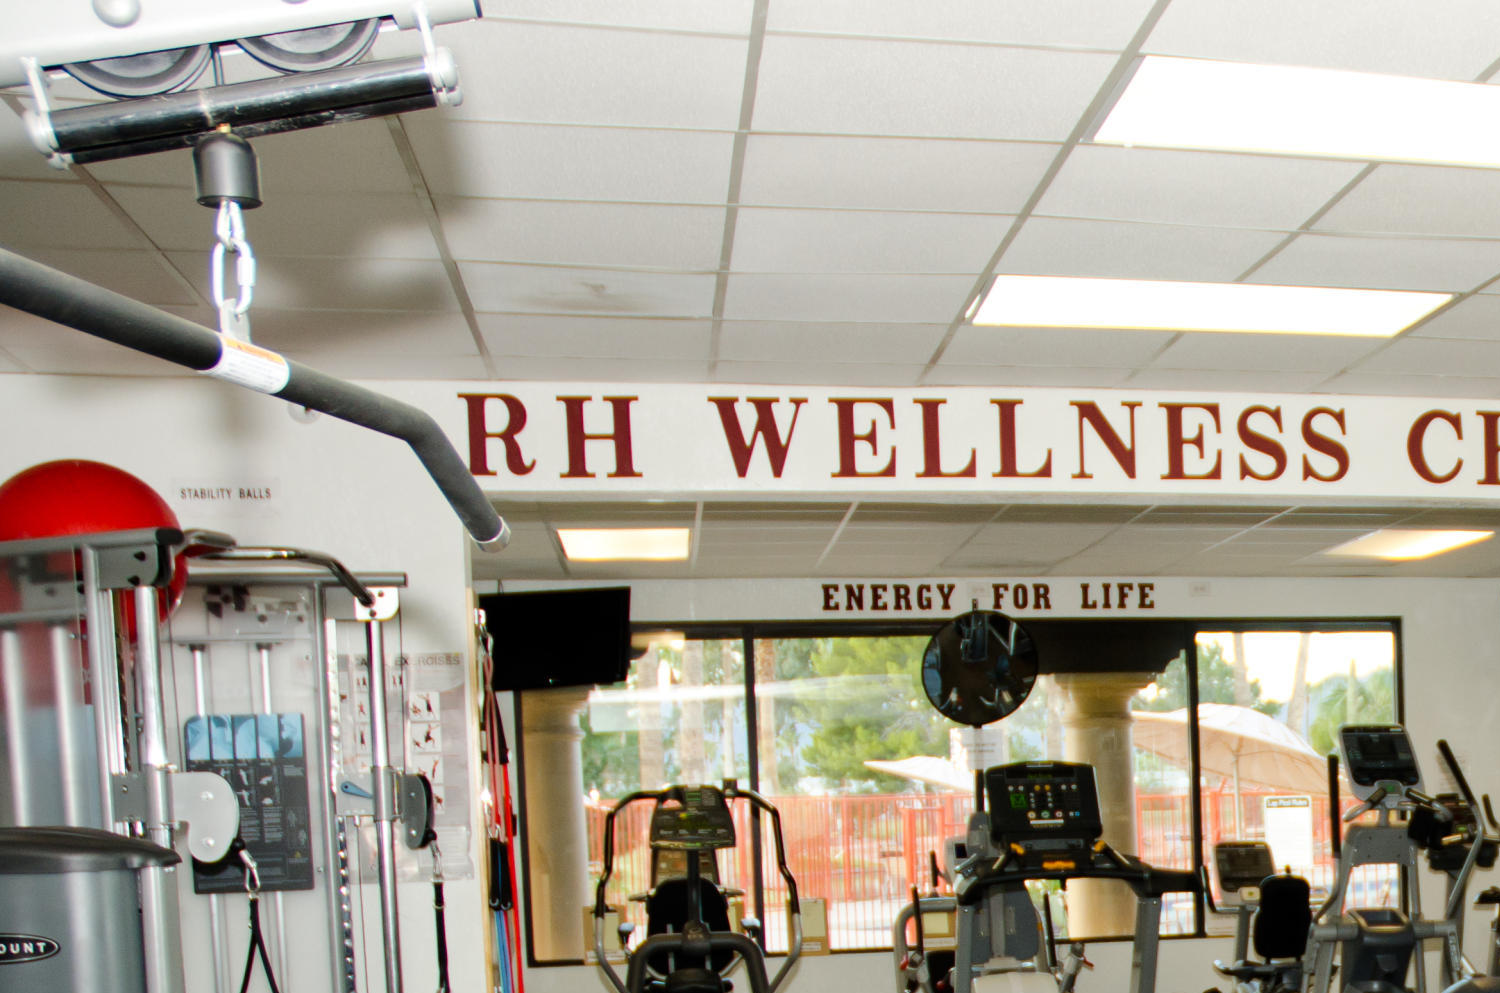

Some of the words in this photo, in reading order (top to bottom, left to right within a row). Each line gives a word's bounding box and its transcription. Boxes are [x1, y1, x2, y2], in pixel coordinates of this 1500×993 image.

[457, 393, 643, 479] RH
[707, 397, 1350, 482] WELLNESS
[180, 487, 232, 500] STABILITY
[239, 487, 271, 500] BALLS
[822, 583, 956, 611] ENERGY
[991, 583, 1052, 610] FOR
[1080, 583, 1155, 609] LIFE
